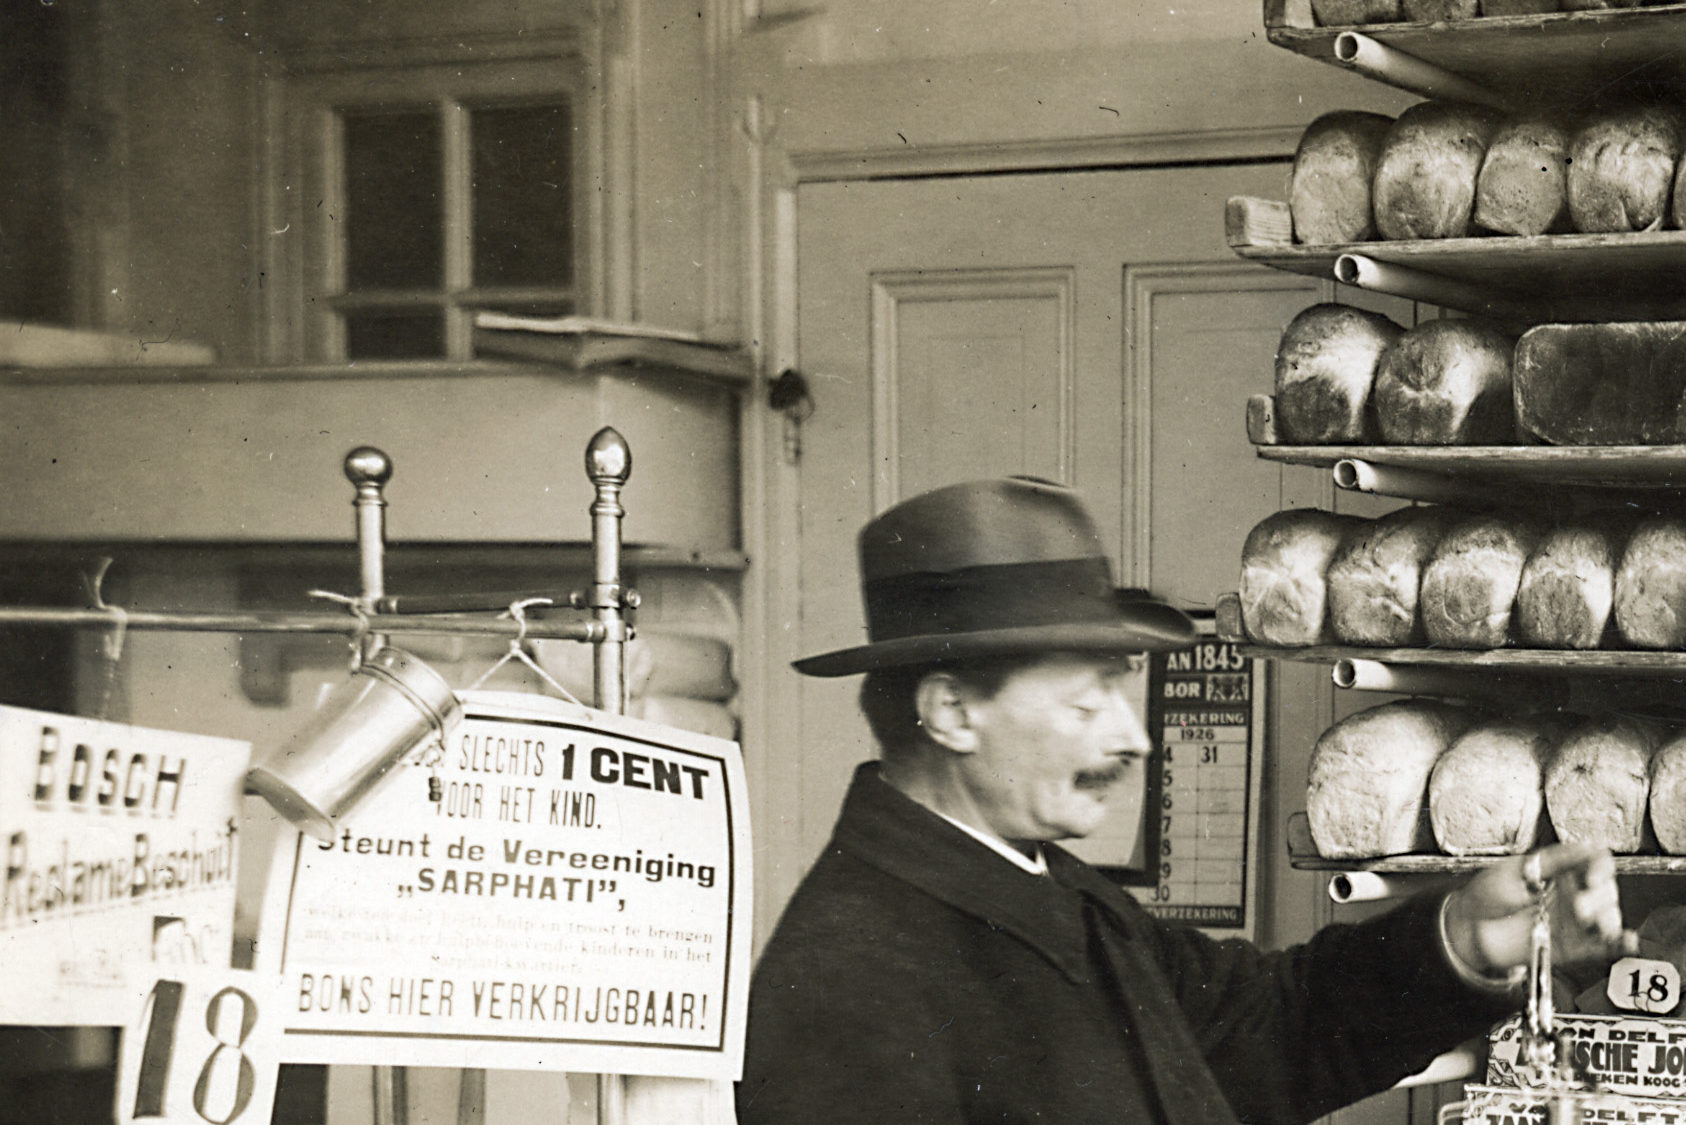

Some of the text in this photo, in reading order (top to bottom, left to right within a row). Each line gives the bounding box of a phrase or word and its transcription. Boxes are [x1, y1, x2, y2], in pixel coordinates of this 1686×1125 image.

[1195, 644, 1244, 670] 1845
[1181, 728, 1215, 740] 1926
[34, 726, 187, 813] BOSCH
[460, 734, 546, 777] SLECHTS
[562, 743, 575, 780] 1
[590, 747, 710, 800] CENT
[1201, 746, 1218, 764] 31
[499, 784, 536, 822] HET
[550, 789, 602, 829] KIND.
[318, 828, 715, 888] teunt de Vereeniging
[1628, 969, 1668, 1002] 18
[299, 974, 709, 1031] BONS HIER VERKRIJGBAAR!
[1552, 1026, 1595, 1039] AN
[1643, 1076, 1681, 1088] KOOG
[1509, 1102, 1548, 1116] VA
